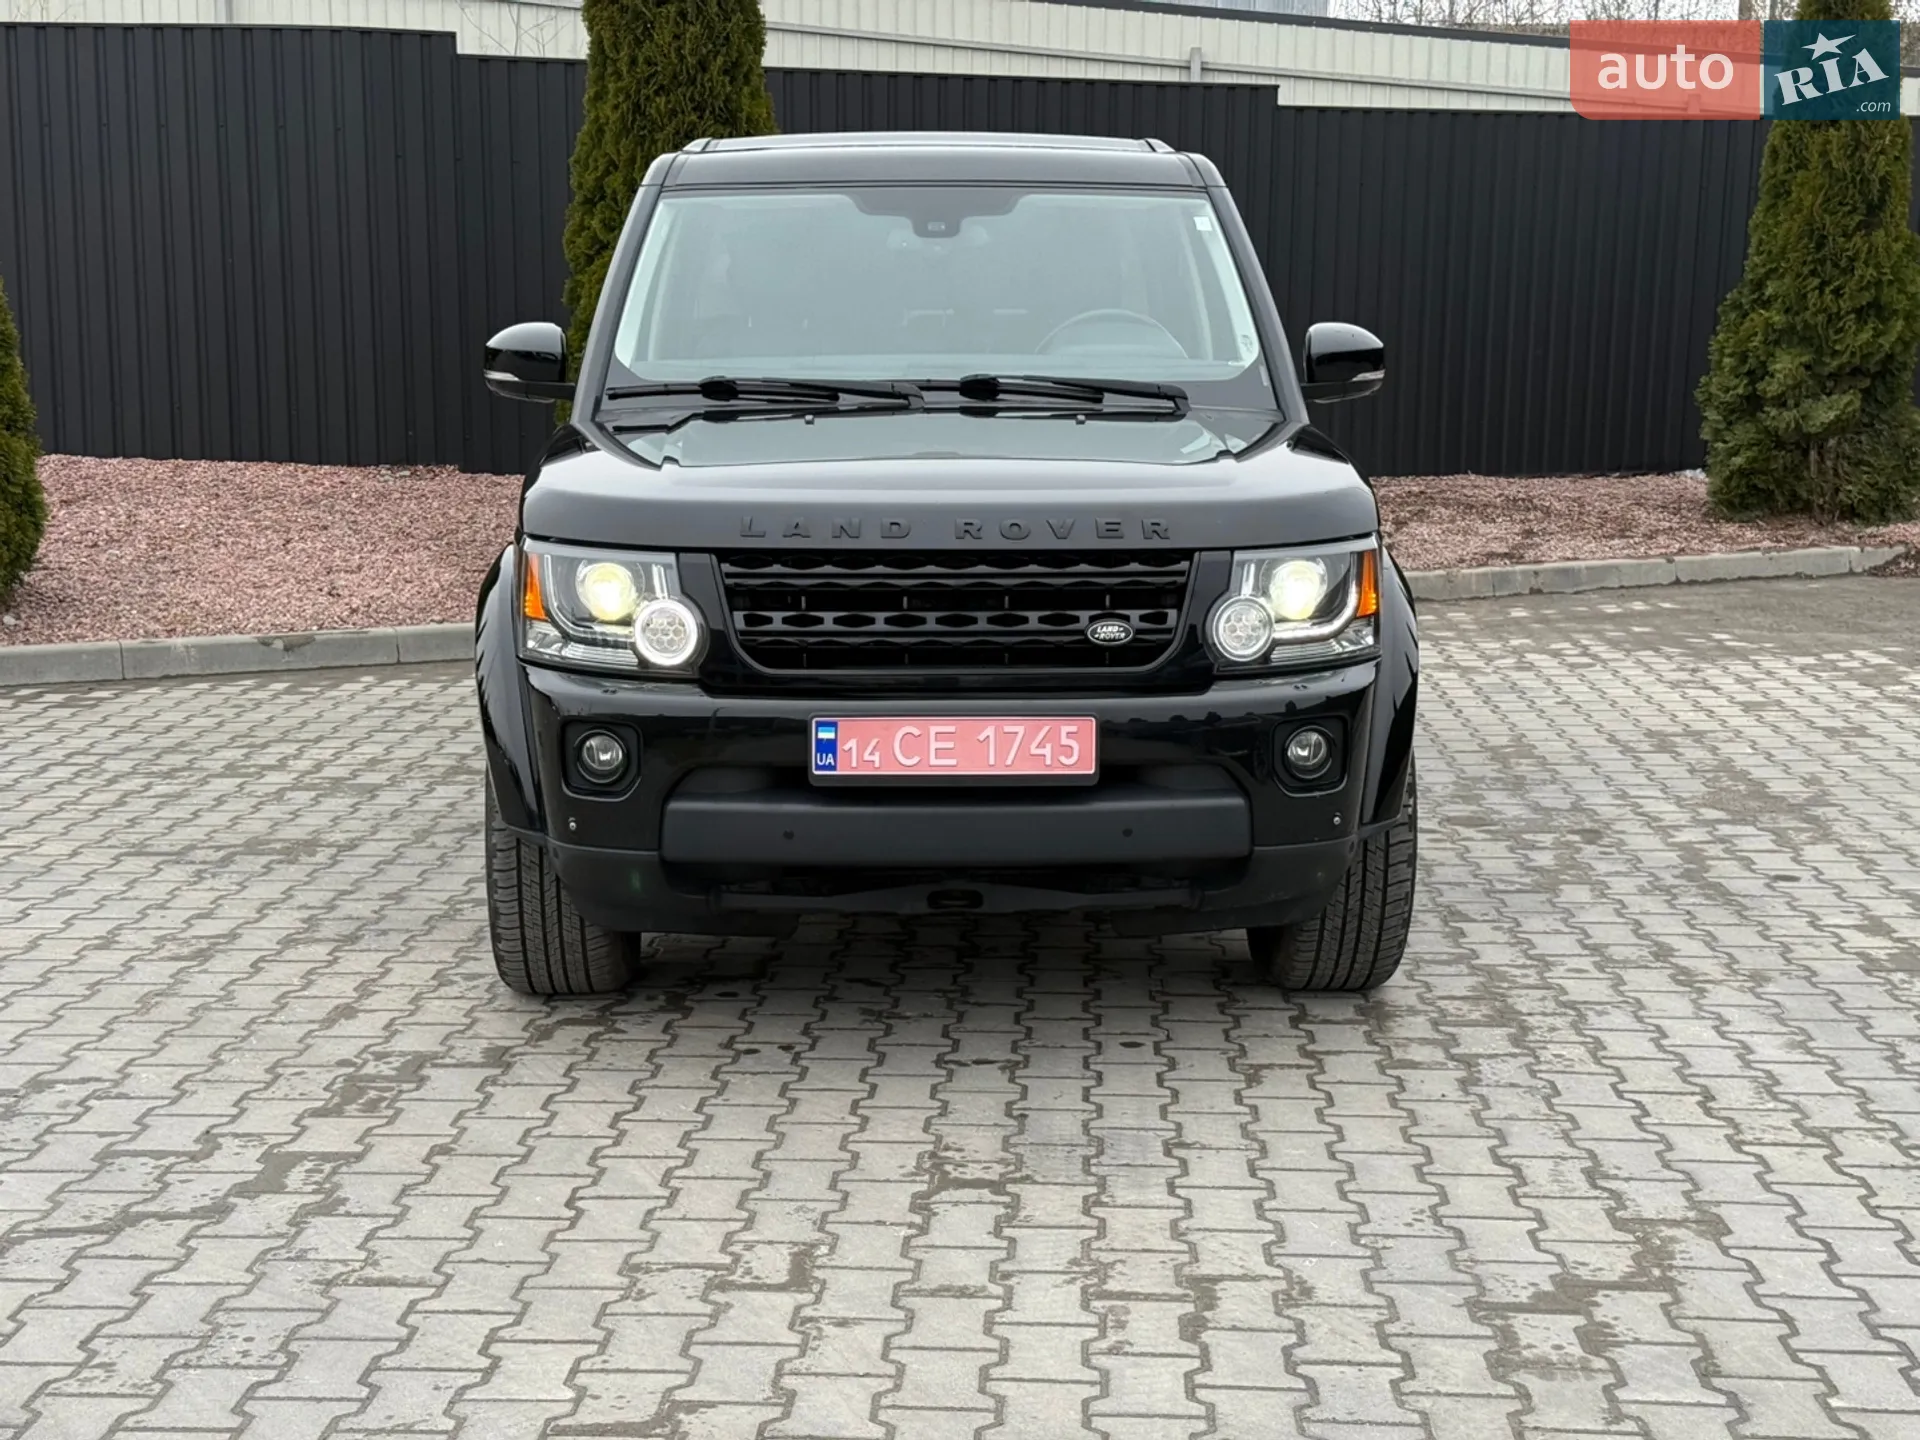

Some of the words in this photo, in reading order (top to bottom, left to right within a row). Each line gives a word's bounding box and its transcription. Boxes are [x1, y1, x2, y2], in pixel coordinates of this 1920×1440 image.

[740, 516, 911, 539] LAND
[955, 517, 1171, 540] ROVER
[842, 738, 880, 768] 14
[893, 725, 958, 767] CE
[976, 725, 1080, 767] 1745
[816, 752, 835, 766] UA
